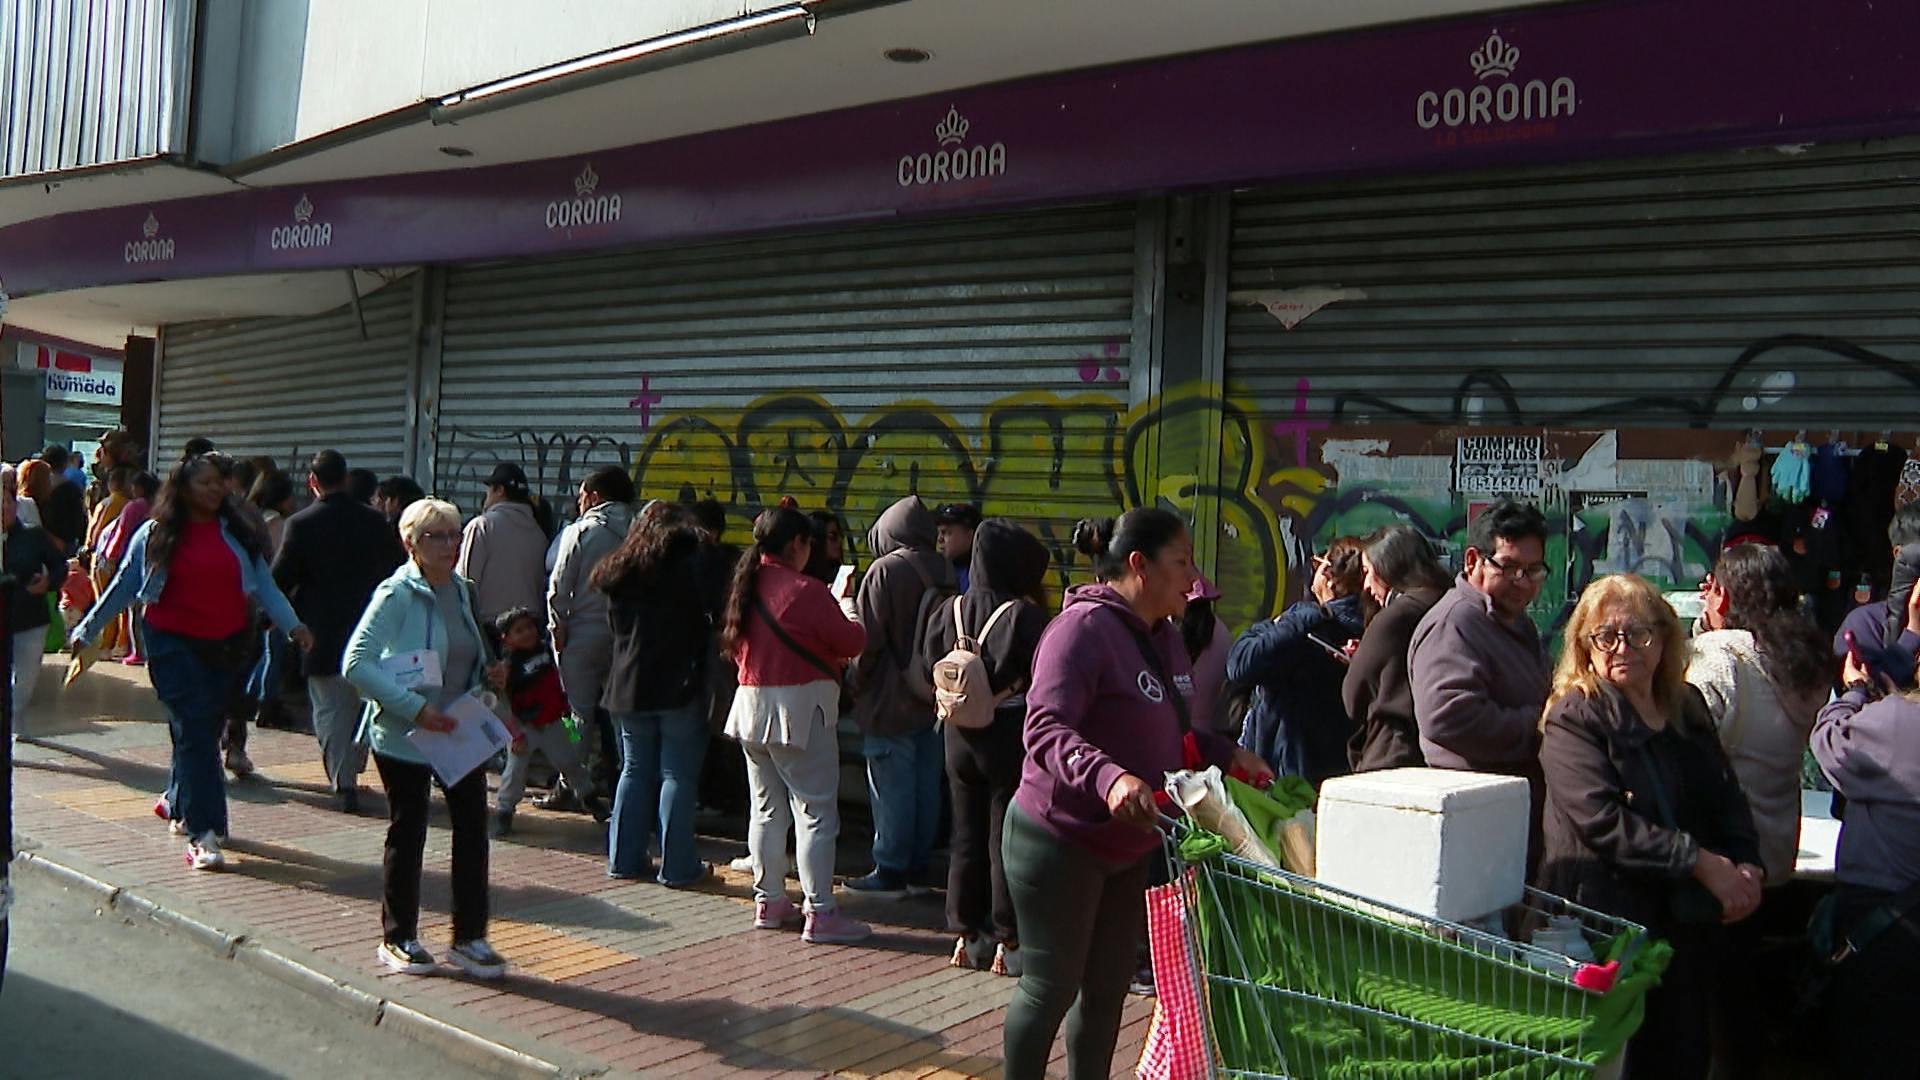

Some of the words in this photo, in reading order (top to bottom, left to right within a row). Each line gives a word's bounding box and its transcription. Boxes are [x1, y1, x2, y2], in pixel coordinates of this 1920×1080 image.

[1417, 76, 1576, 129] CORONA
[898, 142, 1006, 187] CORONA
[545, 194, 622, 229] CORONA
[271, 222, 333, 250] CORONA
[124, 238, 176, 263] CORONA
[47, 375, 116, 397] humada
[1463, 436, 1539, 450] COMPRO
